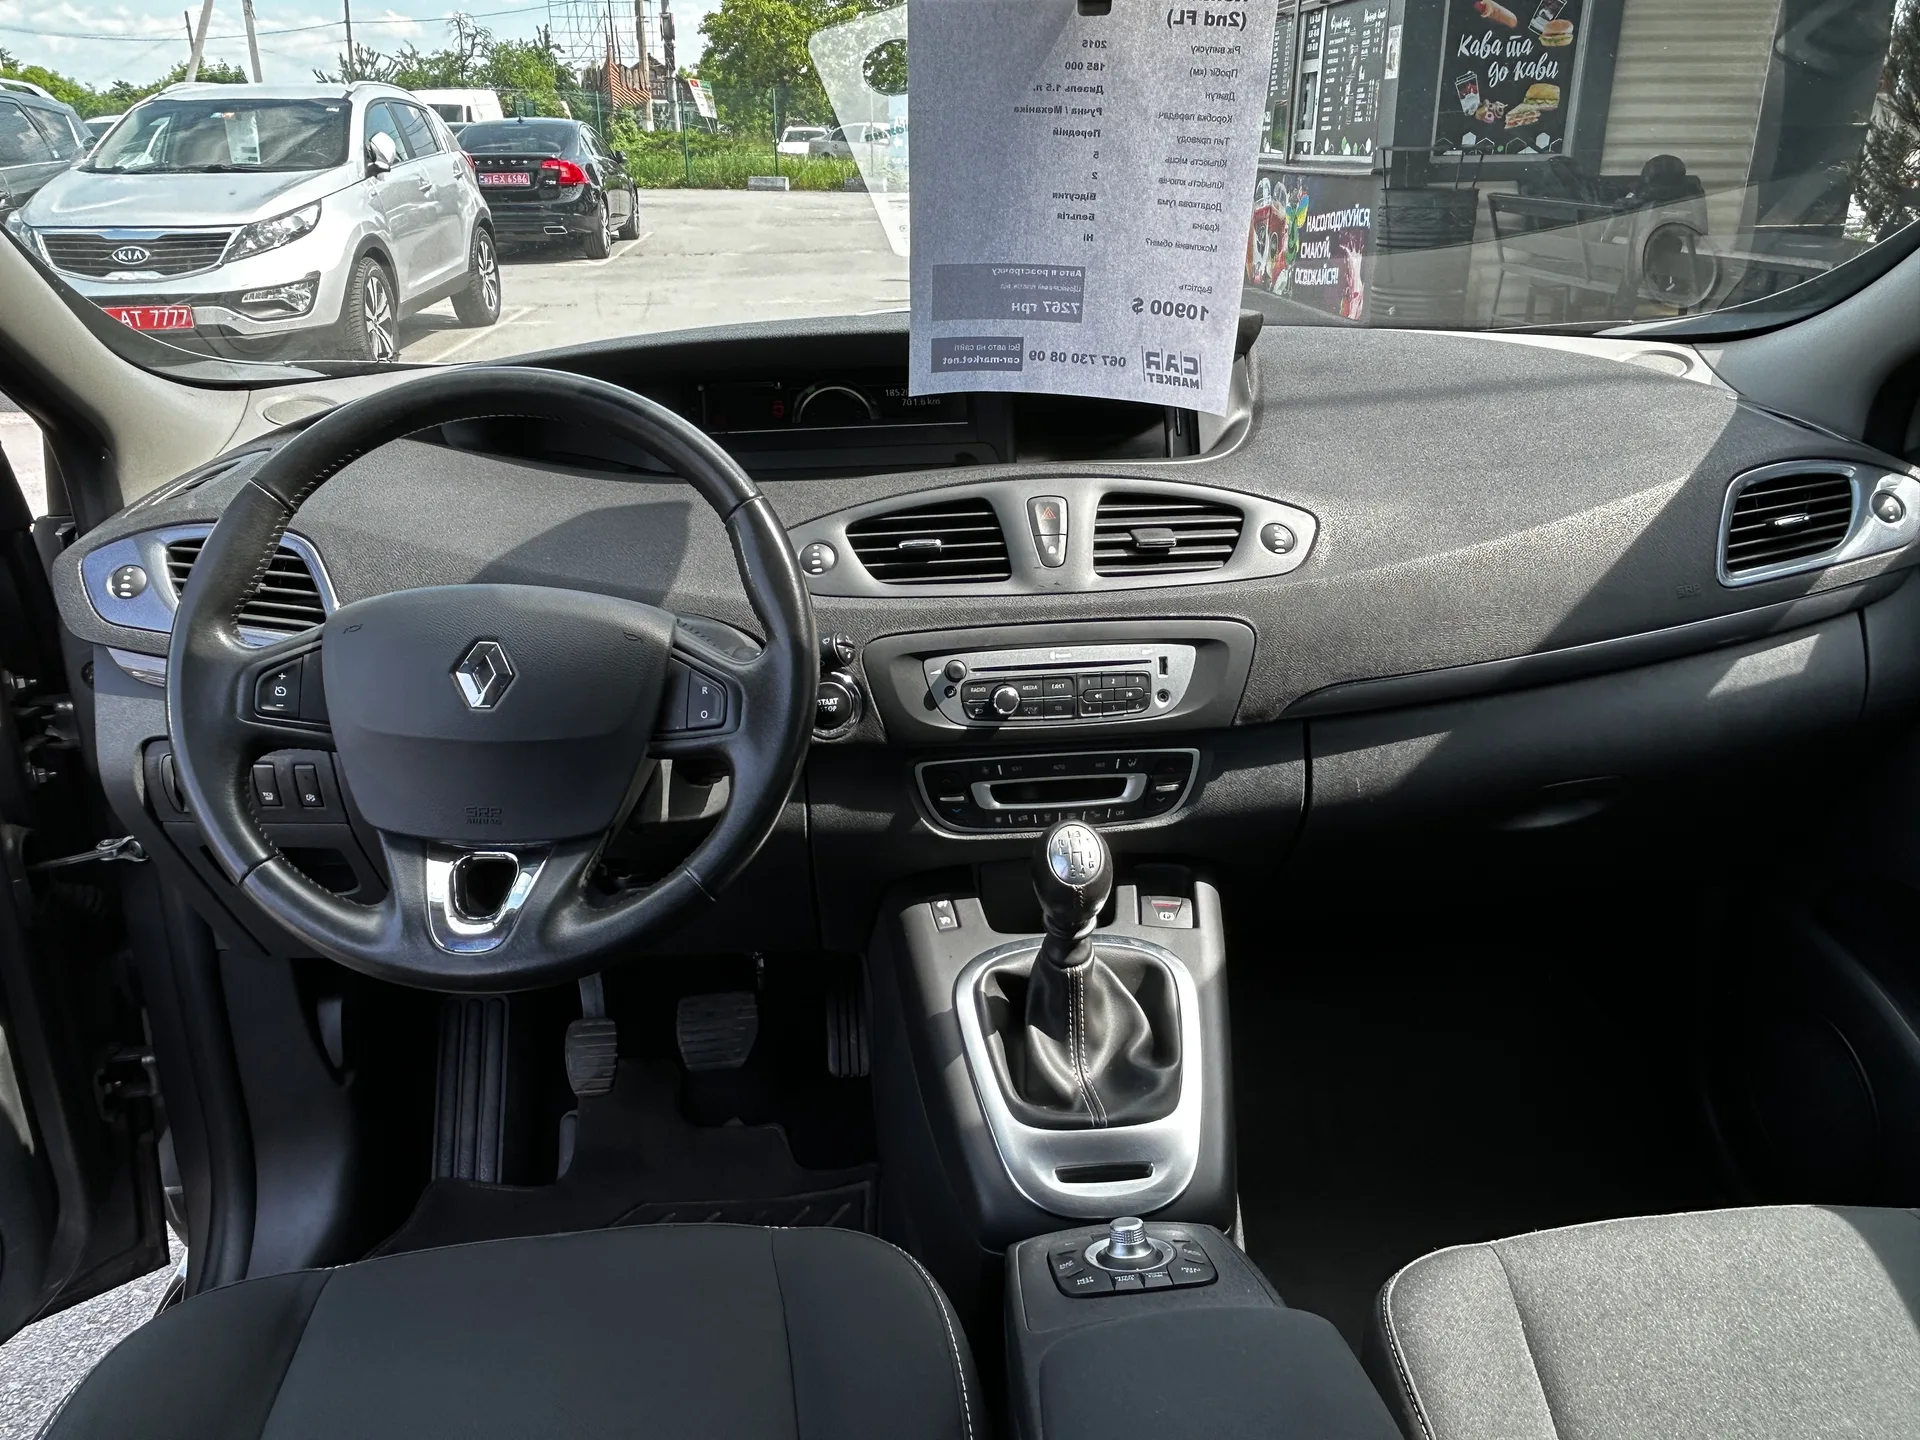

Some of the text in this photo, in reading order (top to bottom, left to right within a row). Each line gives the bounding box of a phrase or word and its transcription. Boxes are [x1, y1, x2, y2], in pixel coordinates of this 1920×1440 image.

[1458, 30, 1534, 59] Кава та
[1488, 52, 1558, 88] до кави
[1306, 203, 1370, 232] НАСОЛОДЖУЙСЯ,
[118, 250, 142, 260] KIA
[1300, 236, 1330, 258] СМАКУЙ,
[121, 310, 187, 327] AT 7777
[702, 686, 708, 694] R
